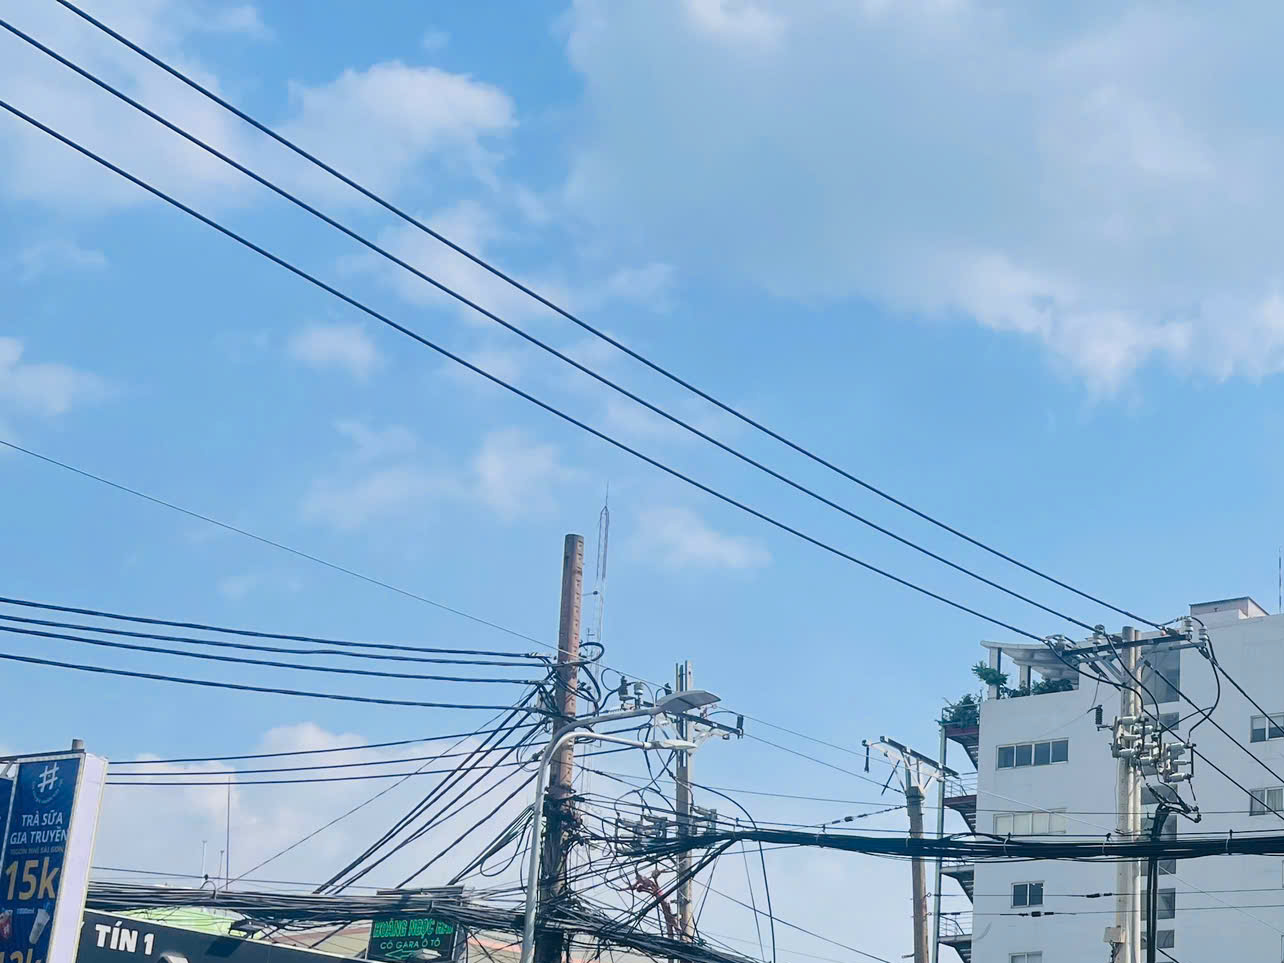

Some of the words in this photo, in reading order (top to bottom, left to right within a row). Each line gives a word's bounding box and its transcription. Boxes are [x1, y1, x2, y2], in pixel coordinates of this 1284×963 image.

[22, 810, 39, 827] TRÀ
[10, 831, 27, 845] GIA
[5, 856, 60, 901] 15k
[95, 921, 138, 953] TÍN
[144, 933, 154, 956] 1
[396, 940, 419, 949] GARA
